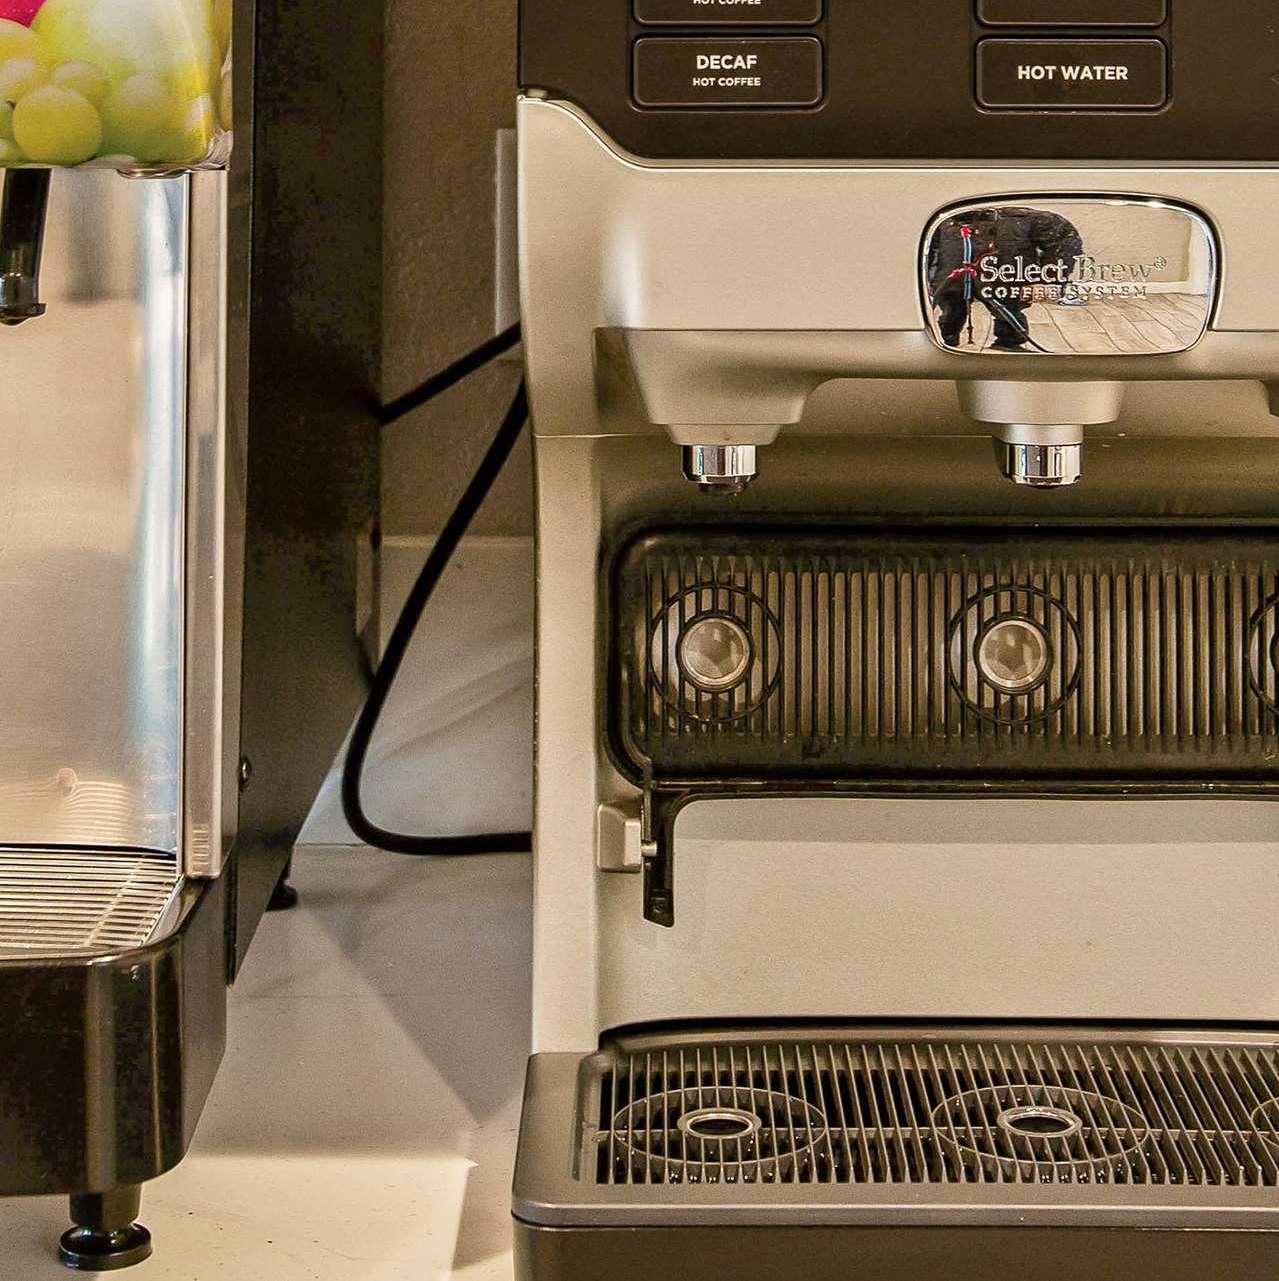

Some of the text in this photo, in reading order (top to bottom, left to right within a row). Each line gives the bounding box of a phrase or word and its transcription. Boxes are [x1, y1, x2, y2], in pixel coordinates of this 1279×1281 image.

[696, 54, 758, 70] DECAF
[1017, 65, 1129, 80] HOT WATER
[692, 77, 761, 87] HOT COFFEE
[979, 255, 1069, 284] Select
[980, 284, 1148, 300] COFFEE SYSTEM
